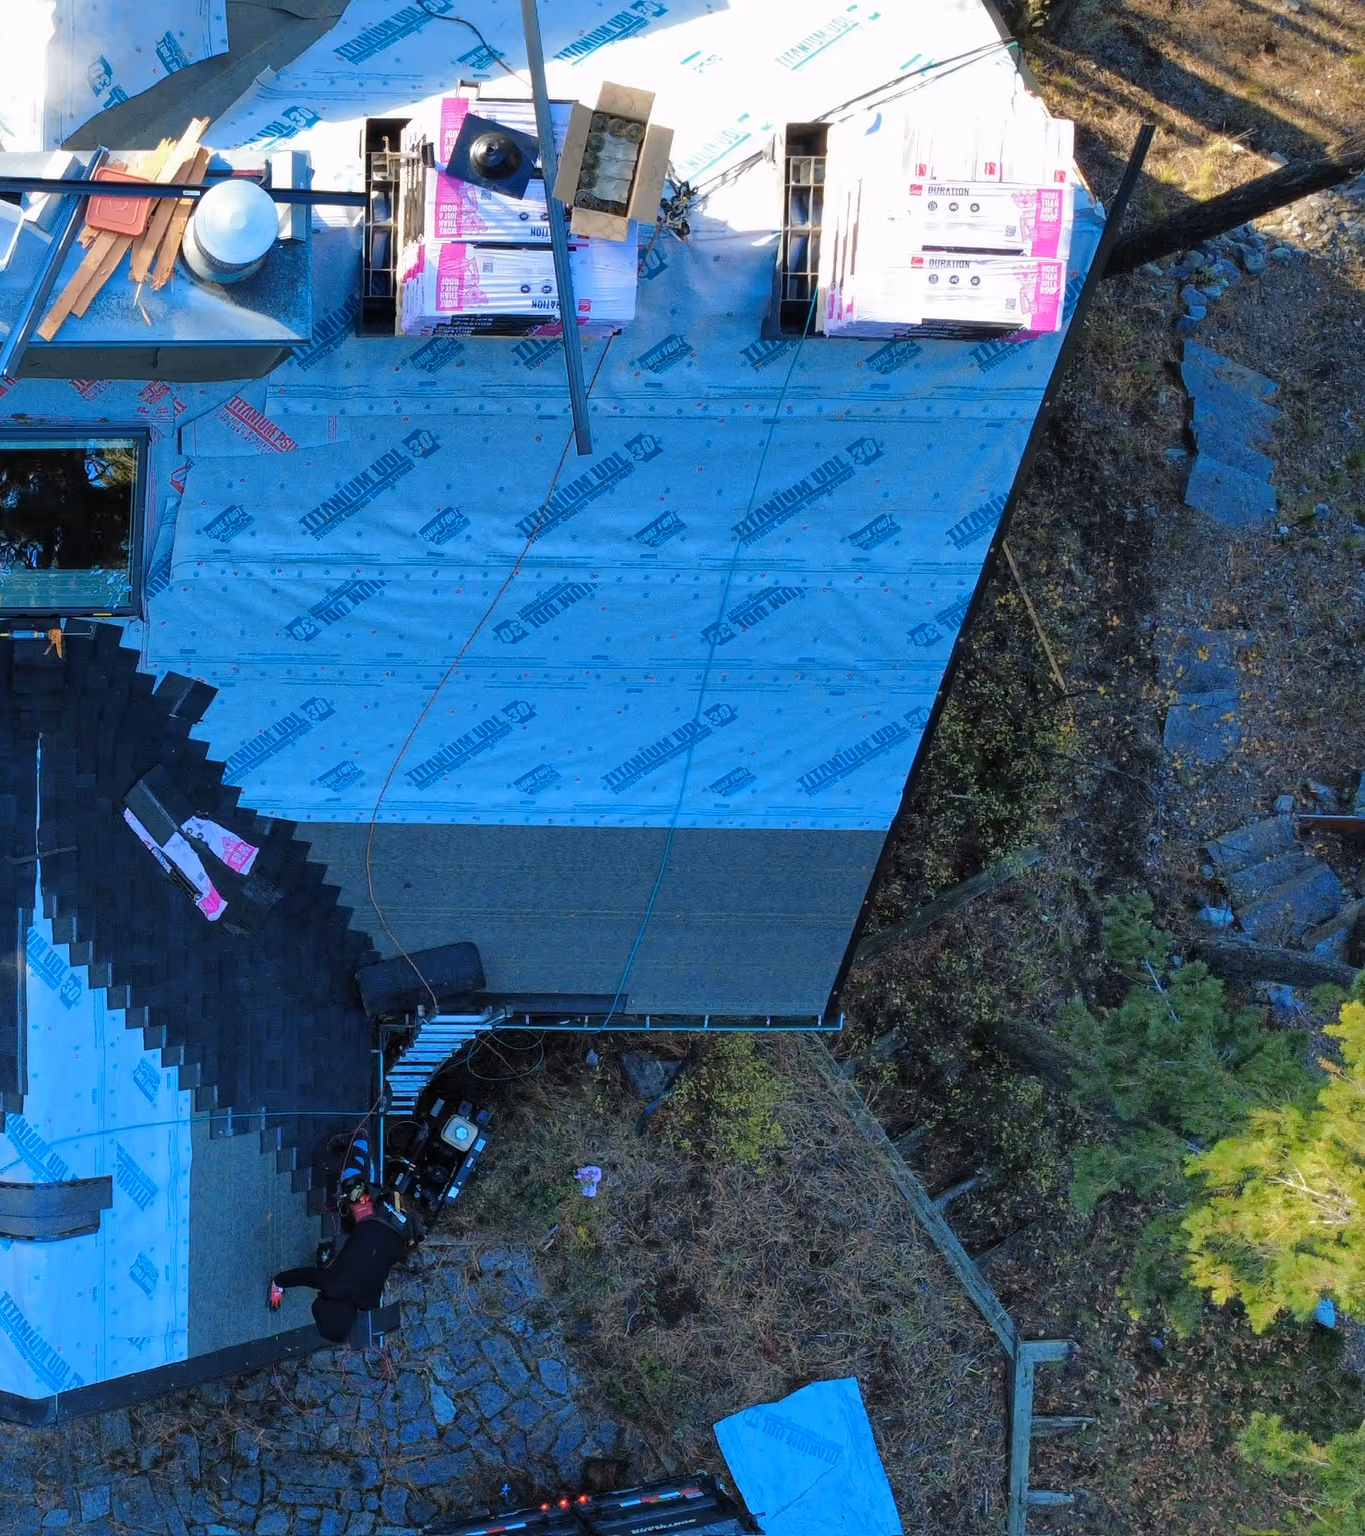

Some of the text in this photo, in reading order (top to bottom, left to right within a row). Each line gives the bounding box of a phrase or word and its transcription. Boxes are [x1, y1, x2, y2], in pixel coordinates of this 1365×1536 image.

[333, 16, 396, 60] TITANIUM
[553, 20, 619, 61] TITANIUM
[289, 106, 315, 128] 30
[927, 185, 970, 197] DURATION
[1041, 191, 1059, 200] MORE
[1041, 200, 1058, 208] THAN
[1040, 215, 1059, 223] ROOF
[928, 258, 971, 269] DURATION
[530, 299, 562, 310] RATION
[640, 335, 686, 371] SURE FOOT
[227, 395, 279, 440] TITANIUM
[298, 468, 375, 534] TITANIUM
[368, 447, 409, 478] UDL
[514, 472, 596, 535] TITANIUM
[589, 451, 631, 481] UDL
[730, 477, 814, 537] TITANIUM
[809, 455, 851, 486] UDL
[205, 505, 245, 540] SURE FOOT
[423, 508, 461, 542] SURE FOOT
[655, 511, 677, 530] FOOT
[317, 600, 353, 627] UDL
[524, 602, 561, 629] UDL
[735, 604, 771, 632] UDL
[271, 711, 305, 736] UDL
[405, 731, 475, 784] TITANIUM
[471, 713, 507, 739] UDL
[601, 736, 675, 788] TITANIUM
[796, 740, 873, 790] TITANIUM
[871, 720, 908, 745] UDL
[43, 949, 69, 982] UDL
[47, 1351, 72, 1385] UDL
